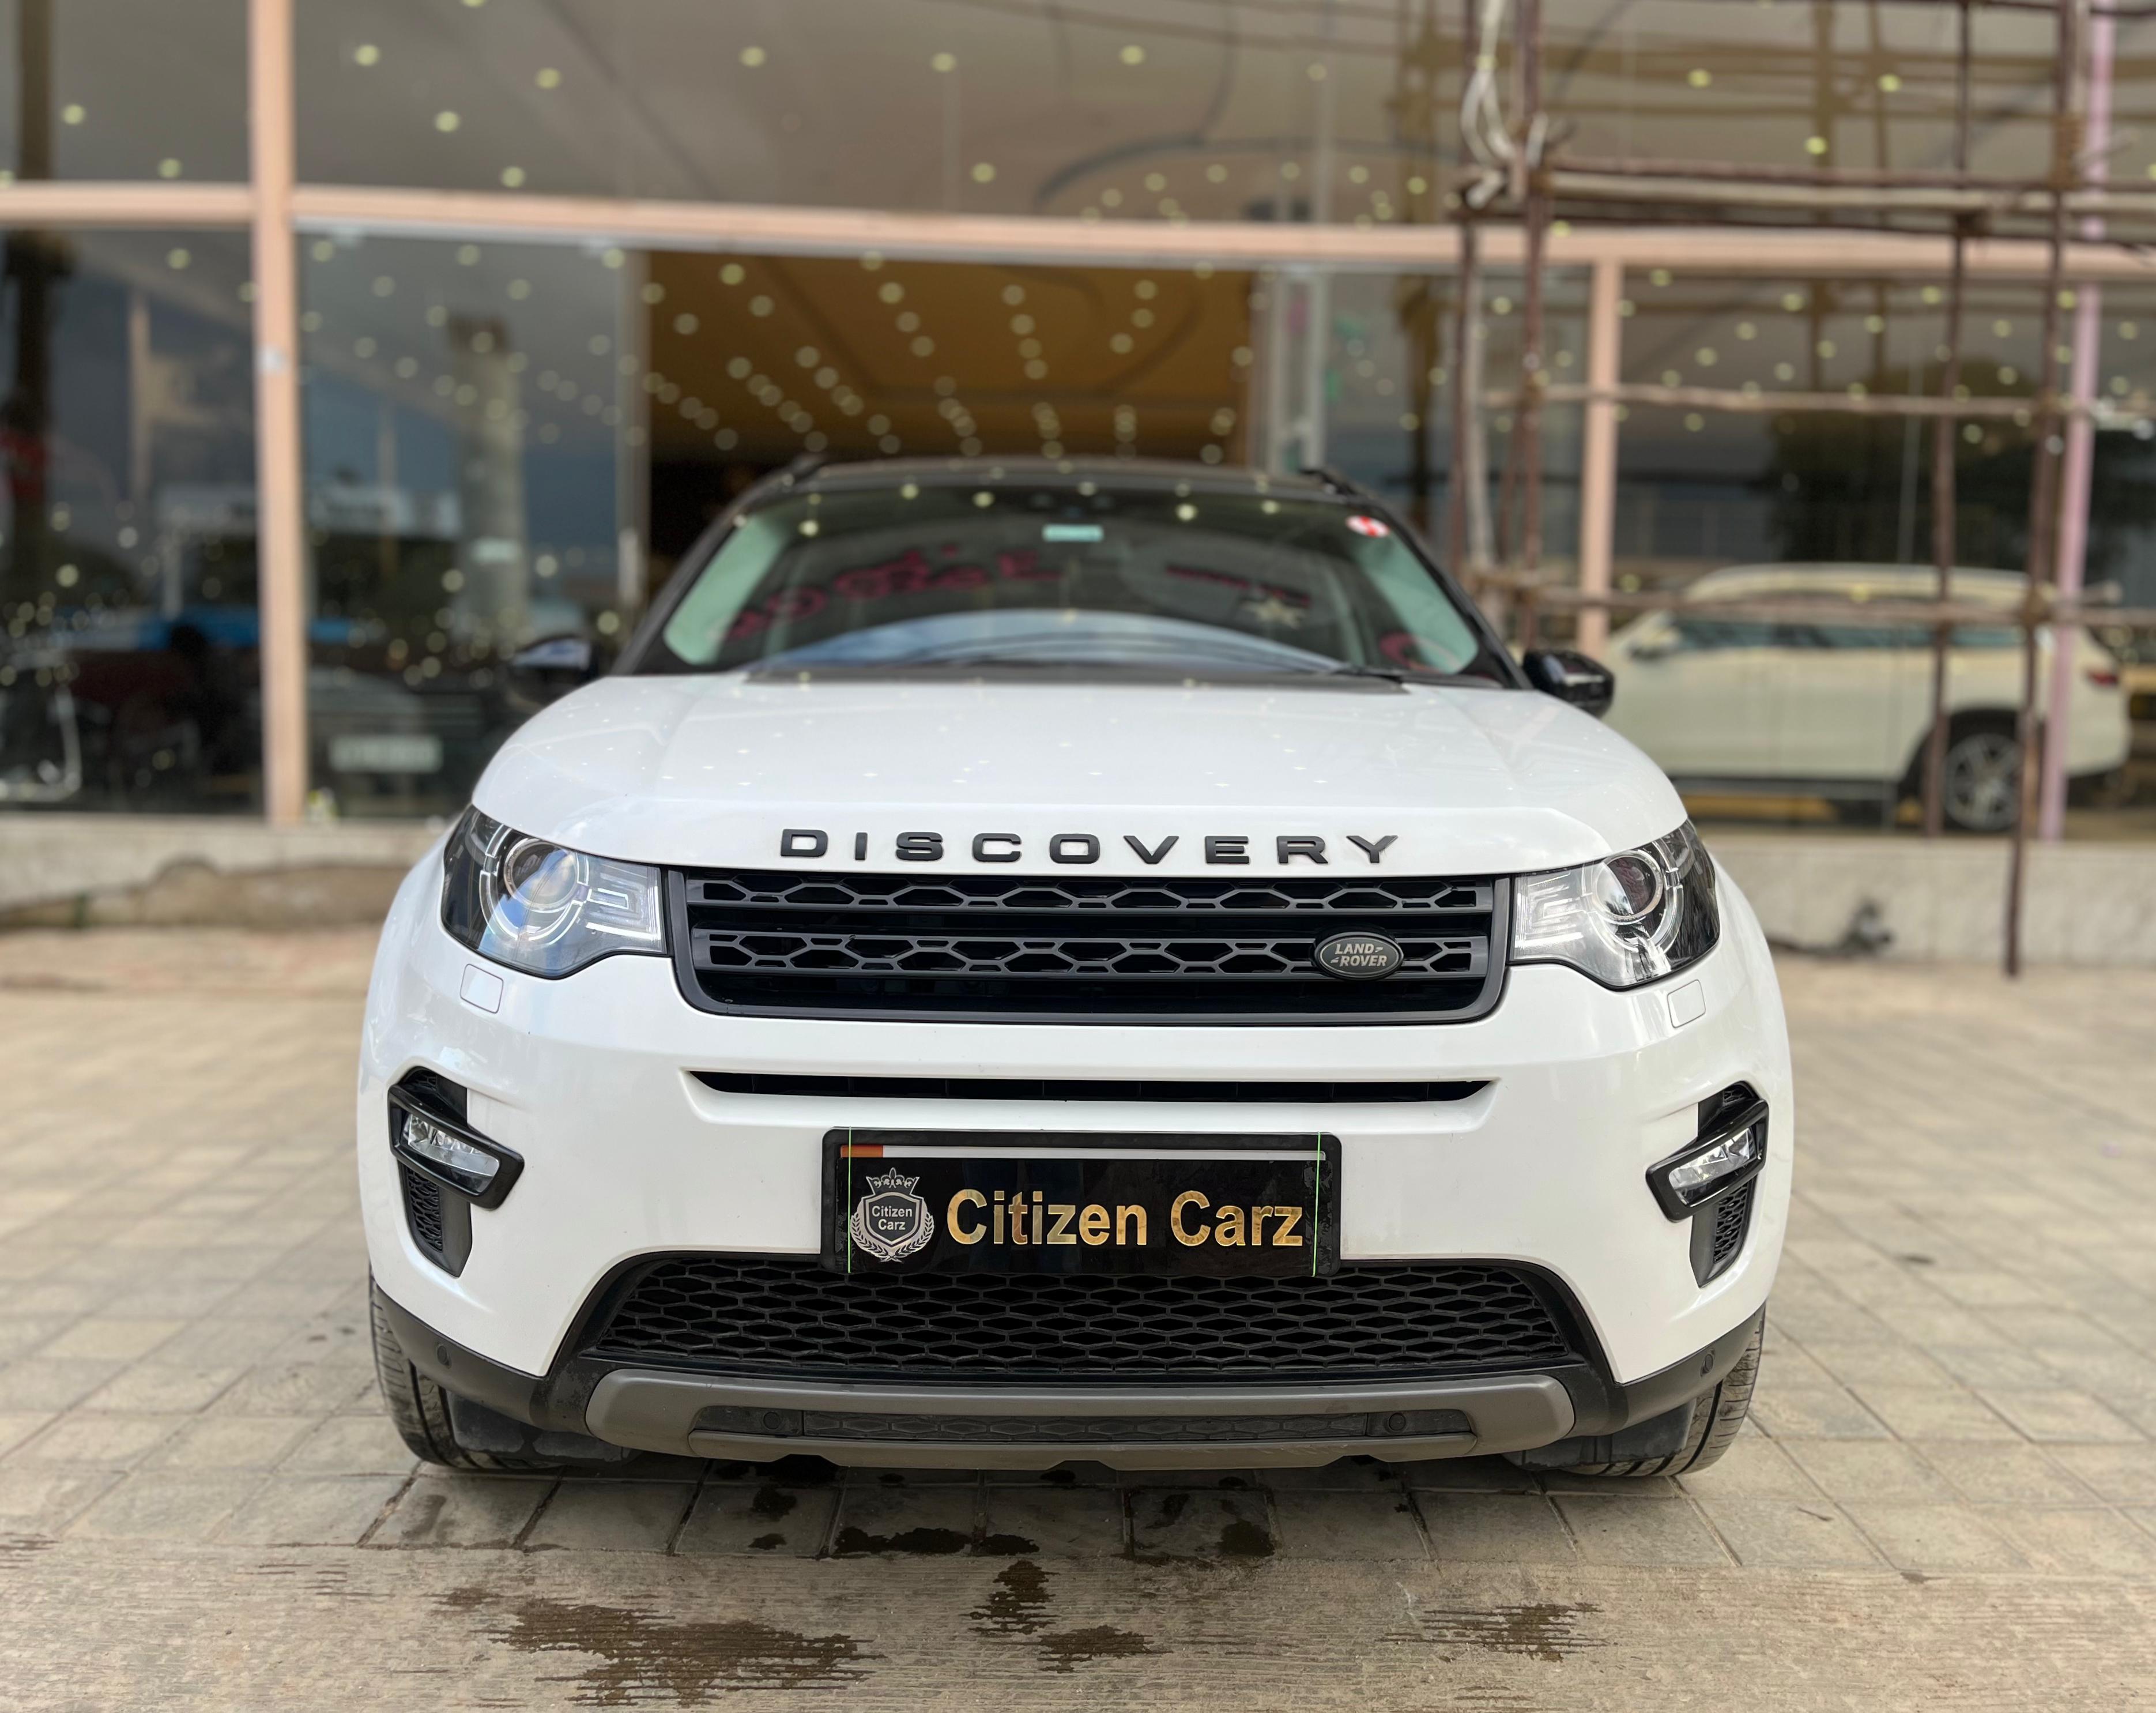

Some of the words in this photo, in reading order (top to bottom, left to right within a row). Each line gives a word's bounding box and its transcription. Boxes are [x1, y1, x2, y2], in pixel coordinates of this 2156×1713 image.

[780, 828, 1399, 864] DISCOVERY
[872, 1206, 913, 1217] Citizen
[947, 1188, 1148, 1245] Citizen
[1170, 1189, 1303, 1247] Carz
[878, 1218, 906, 1230] Carz
